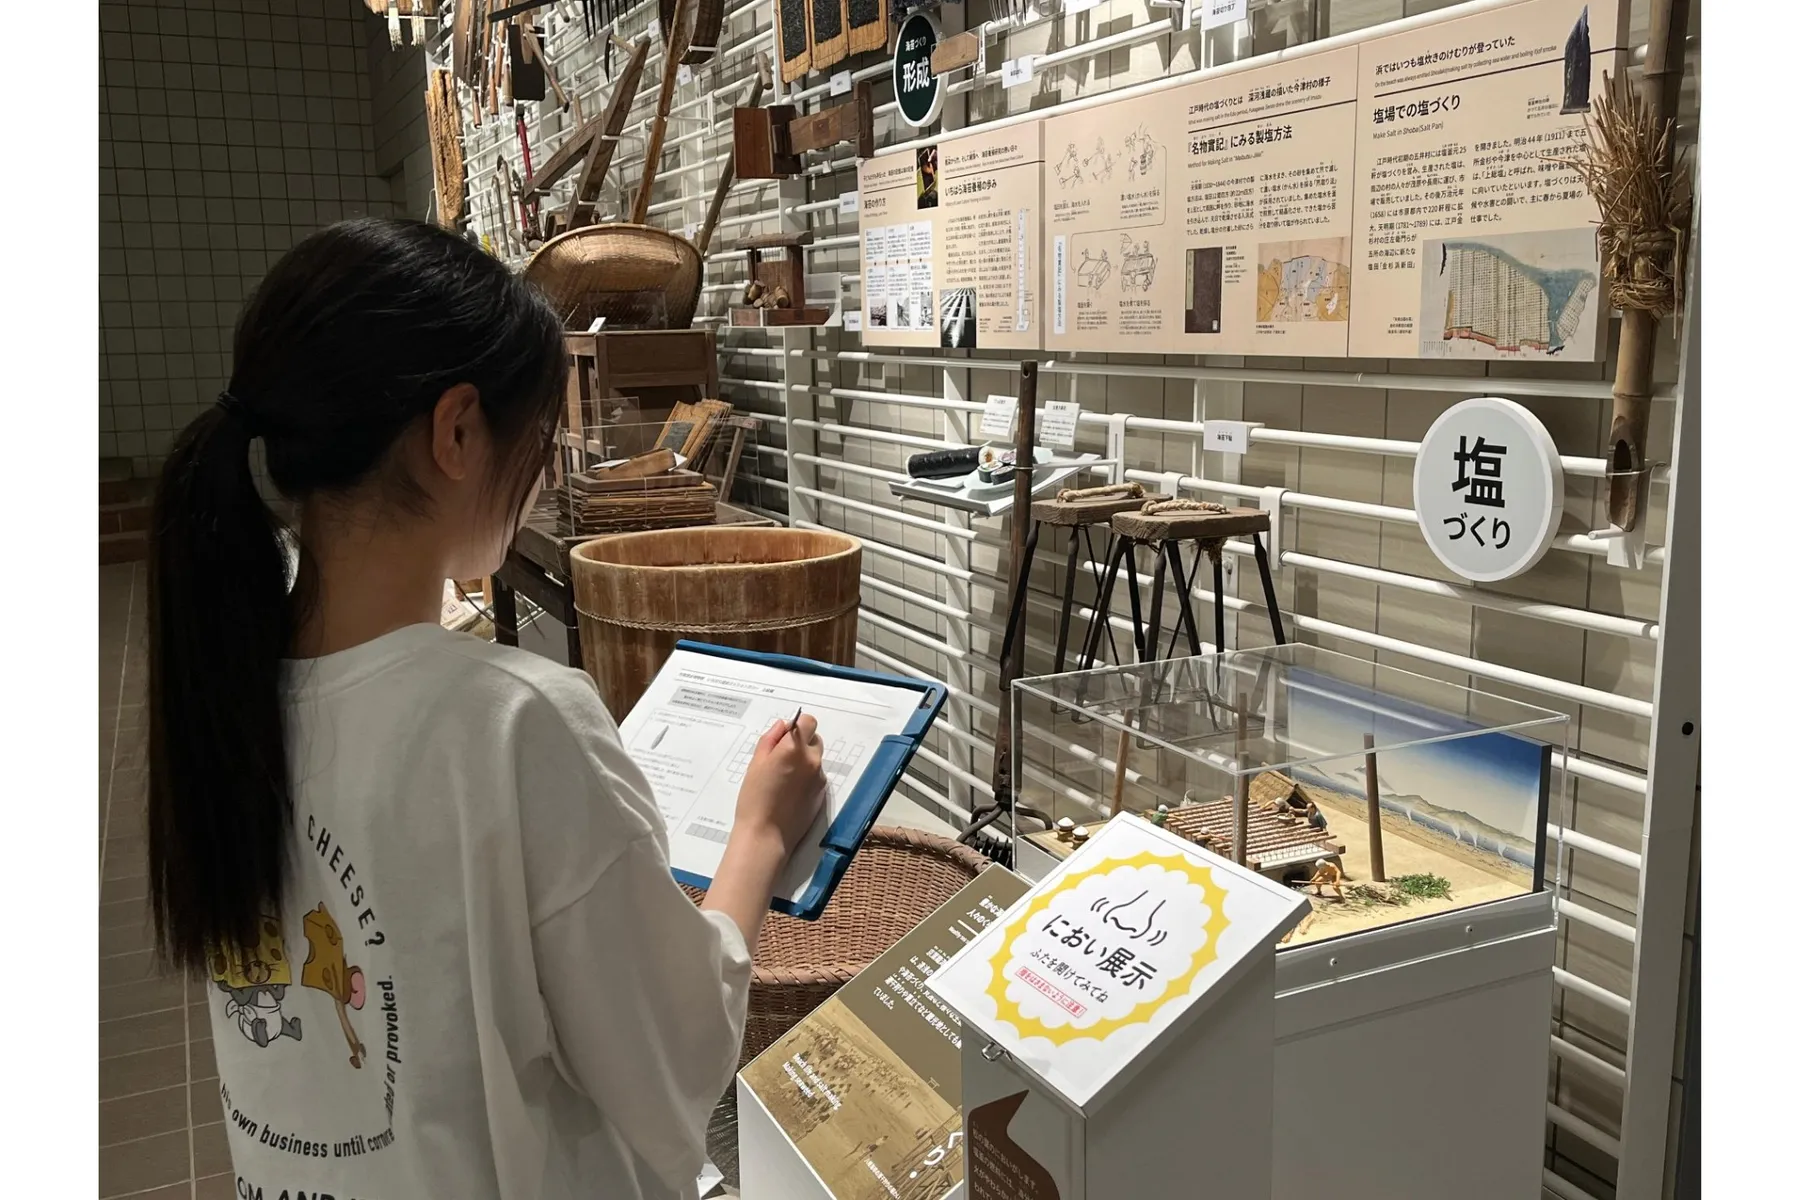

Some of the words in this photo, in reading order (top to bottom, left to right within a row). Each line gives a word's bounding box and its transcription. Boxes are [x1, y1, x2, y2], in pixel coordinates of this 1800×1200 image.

[905, 36, 927, 52] 海苔づくり
[903, 56, 930, 93] 形成
[1373, 94, 1461, 124] 塩場での塩づくり
[1387, 128, 1396, 138] Salt
[1452, 436, 1507, 508] 塩
[1443, 512, 1511, 550] づくり
[308, 814, 385, 946] CHEESE?
[1042, 915, 1158, 990] におい展示
[1030, 948, 1108, 1003] ふたを開けてみてね
[377, 975, 402, 1064] provoked.
[386, 1064, 396, 1084] or
[232, 1109, 258, 1137] own
[259, 1124, 329, 1158] business
[334, 1135, 366, 1158] until
